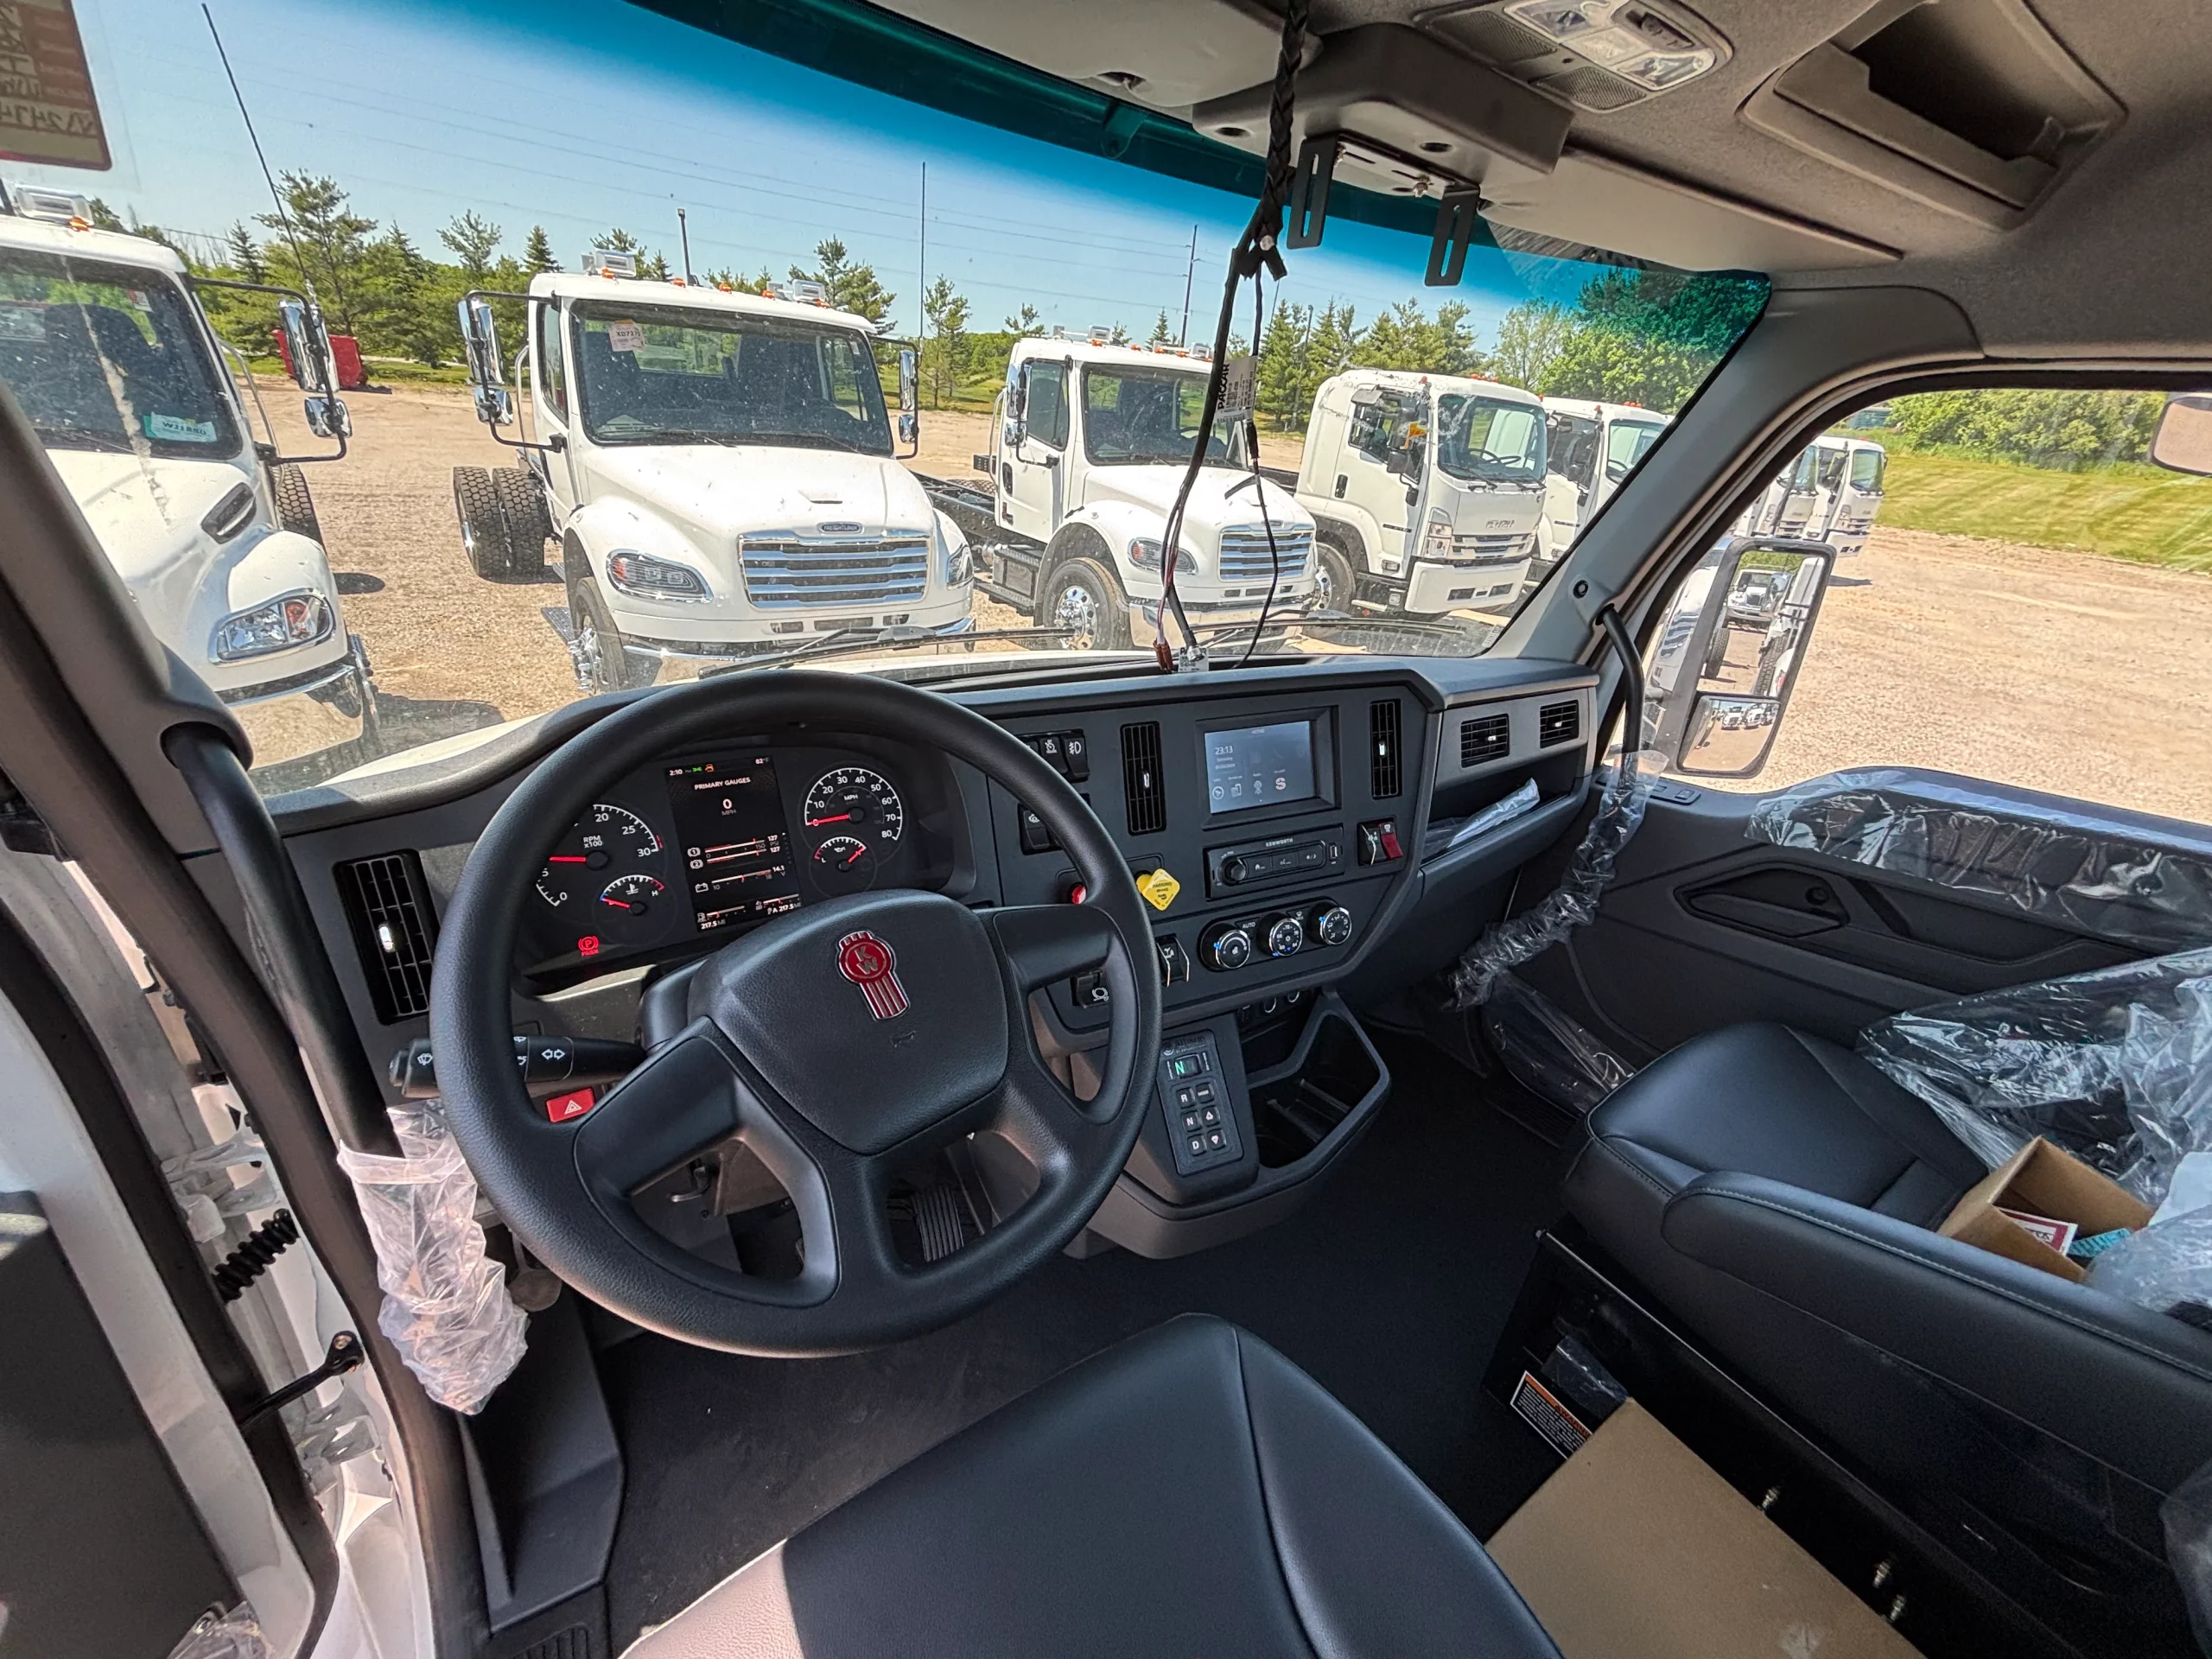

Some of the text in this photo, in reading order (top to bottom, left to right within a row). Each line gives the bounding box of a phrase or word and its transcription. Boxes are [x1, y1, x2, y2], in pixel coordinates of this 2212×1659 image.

[1217, 363, 1230, 410] PACCAR
[1215, 745, 1234, 755] 23:13
[694, 777, 751, 791] PRIMARY GAUGES
[836, 776, 848, 785] 30
[870, 784, 881, 792] 50
[722, 798, 732, 810] 0
[881, 797, 893, 805] 60
[594, 812, 609, 823] 20
[621, 825, 636, 836] 25
[881, 830, 893, 838] 80
[582, 835, 601, 843] RPM
[1265, 837, 1294, 848] KENWORTH
[637, 847, 651, 857] 30
[559, 892, 568, 901] 0
[779, 903, 794, 912] 217.5
[701, 920, 718, 930] 217.5
[1174, 1060, 1185, 1076] N
[1180, 1094, 1188, 1103] R
[1185, 1116, 1194, 1126] N
[1192, 1141, 1199, 1150] D
